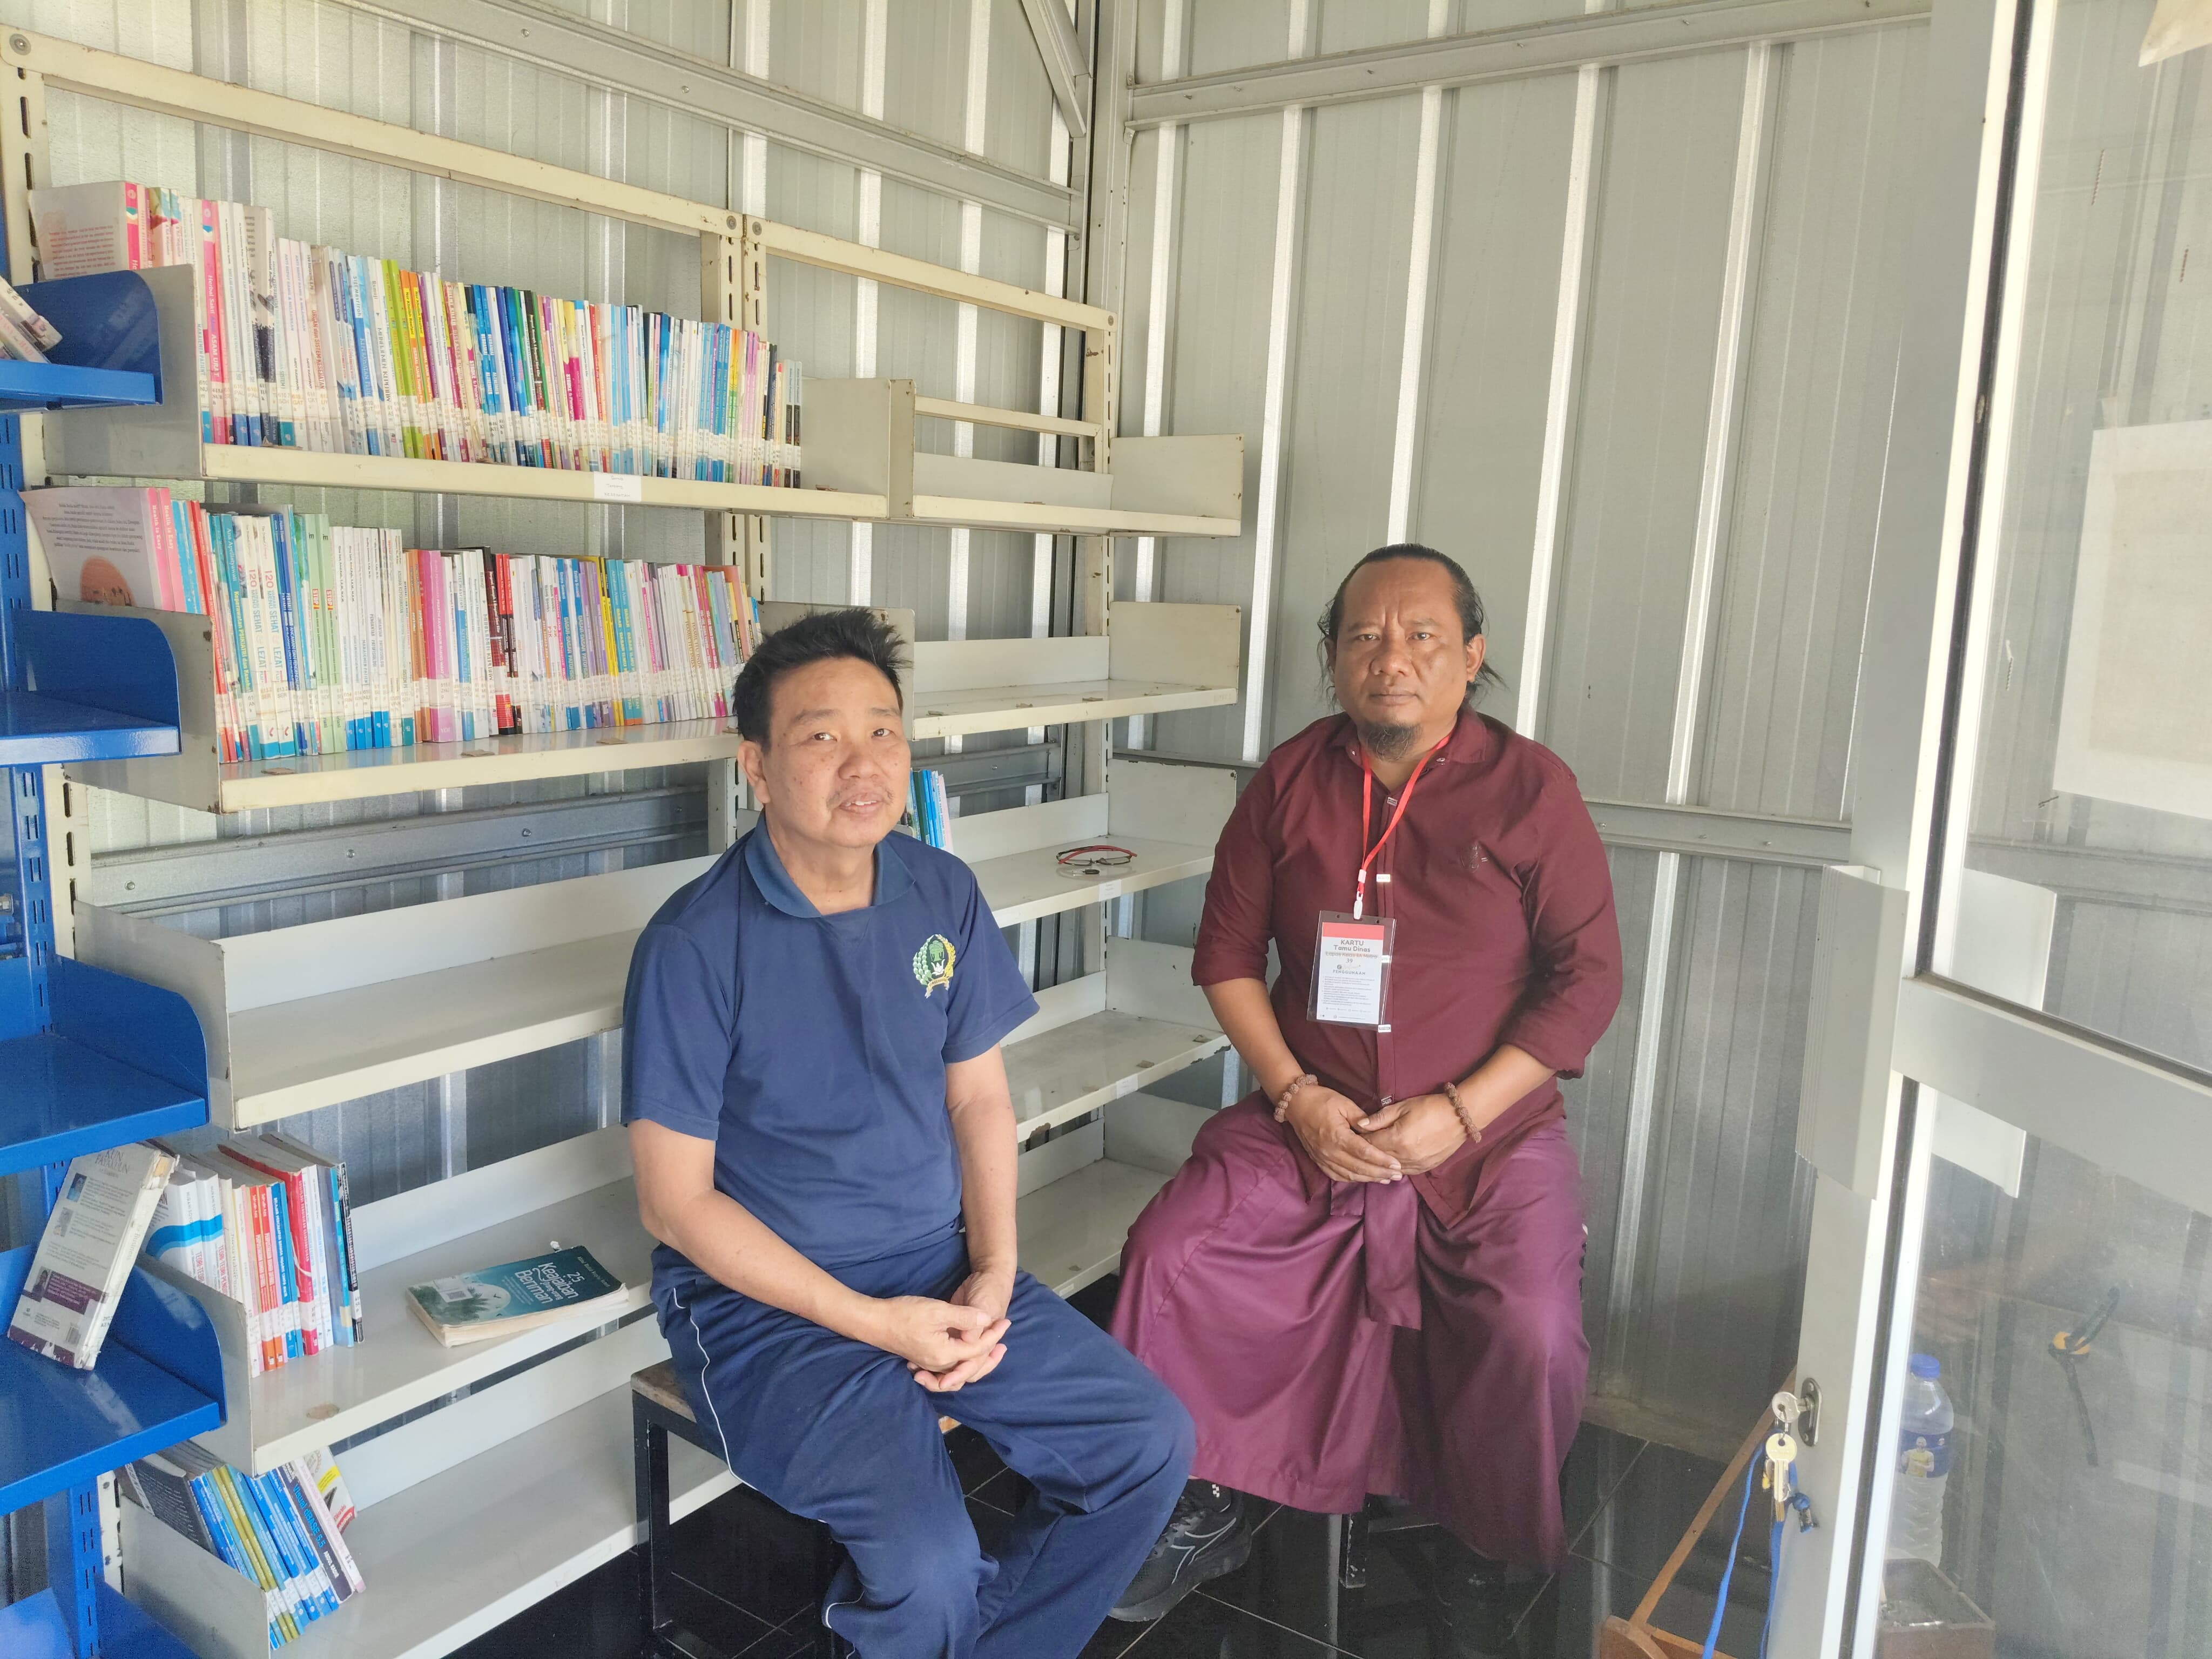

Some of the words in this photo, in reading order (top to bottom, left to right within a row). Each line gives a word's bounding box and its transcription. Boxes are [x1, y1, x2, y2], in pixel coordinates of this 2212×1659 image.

[515, 1270, 554, 1304] Beriman
[532, 1262, 579, 1299] Keajaiban
[568, 1271, 586, 1284] 25
[293, 1483, 308, 1509] Visual
[304, 1508, 321, 1536] dBASE
